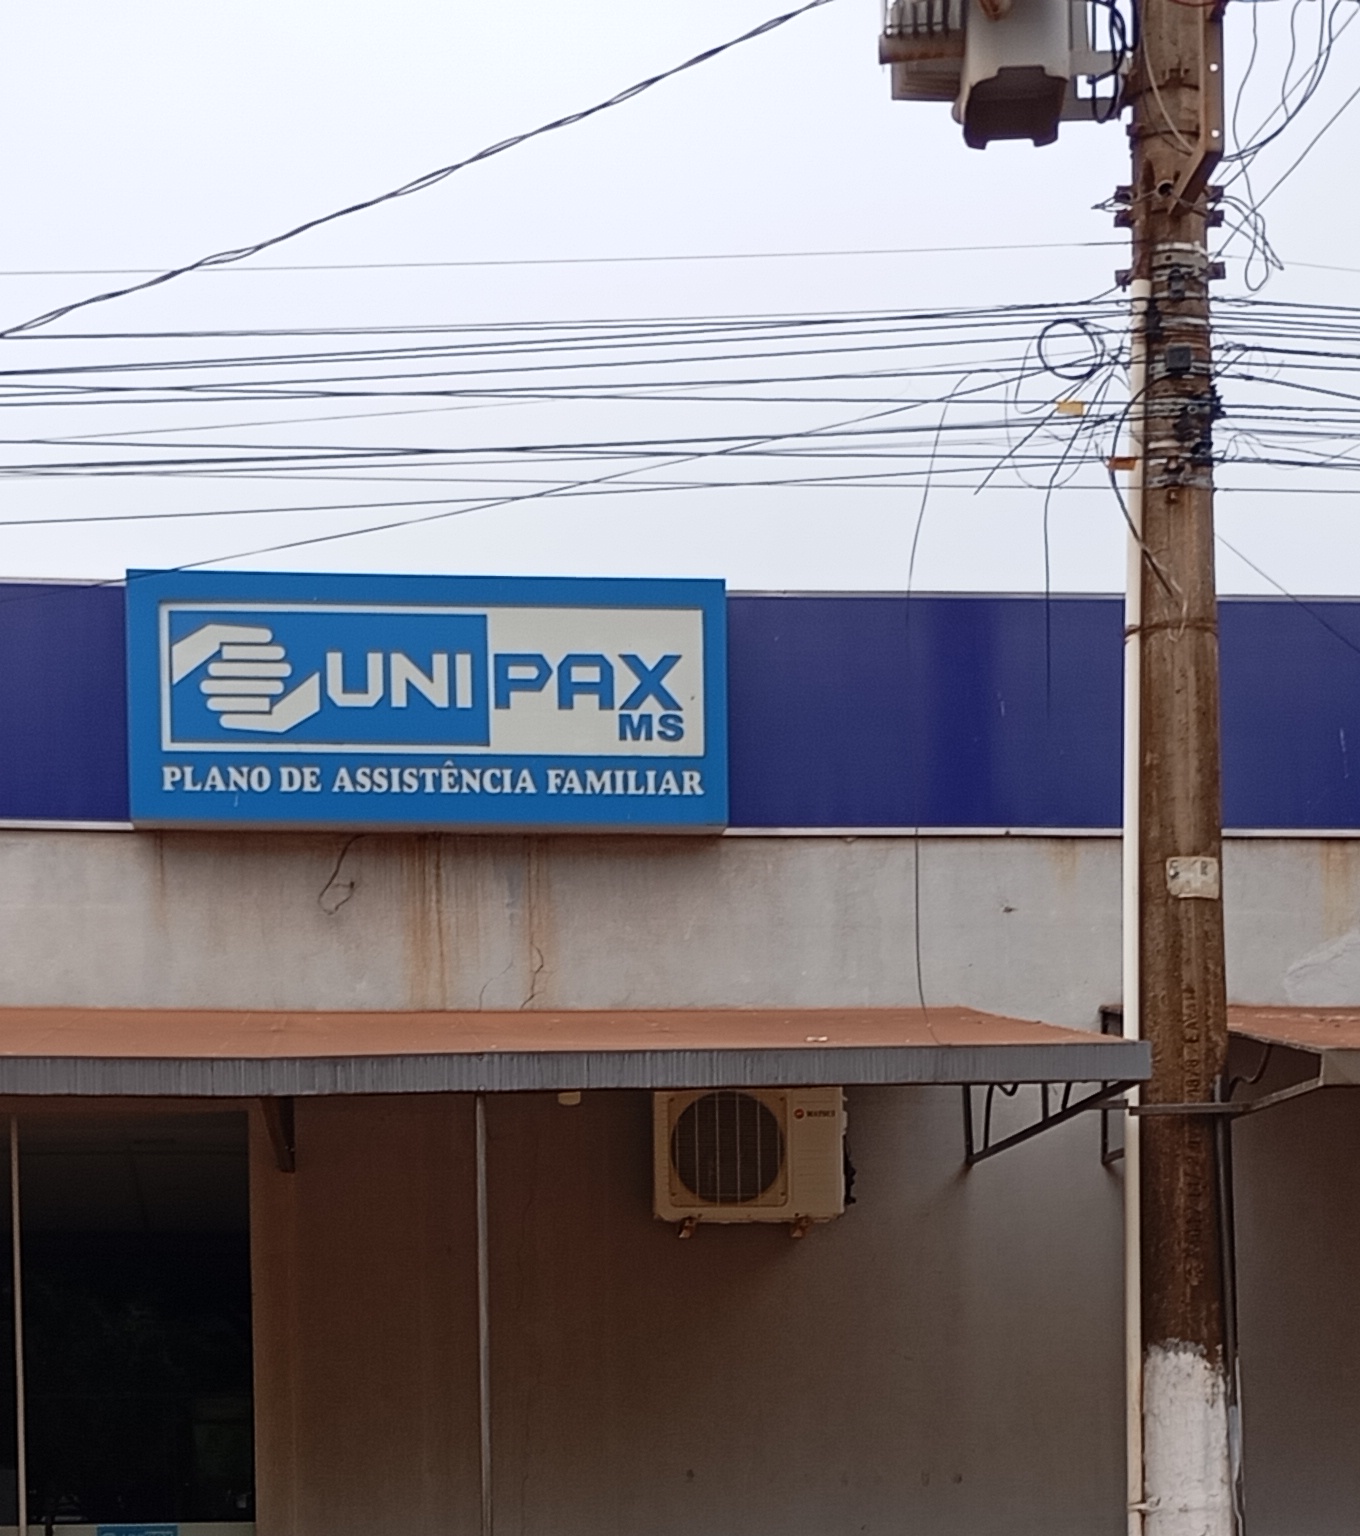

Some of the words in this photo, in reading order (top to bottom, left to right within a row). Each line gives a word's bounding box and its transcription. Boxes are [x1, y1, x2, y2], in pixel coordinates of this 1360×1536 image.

[618, 713, 686, 743] MS
[162, 765, 271, 793] PLANO
[279, 766, 322, 794] DE
[331, 760, 537, 795] ASSISTÊNCIA
[546, 768, 705, 796] FAMILIAR
